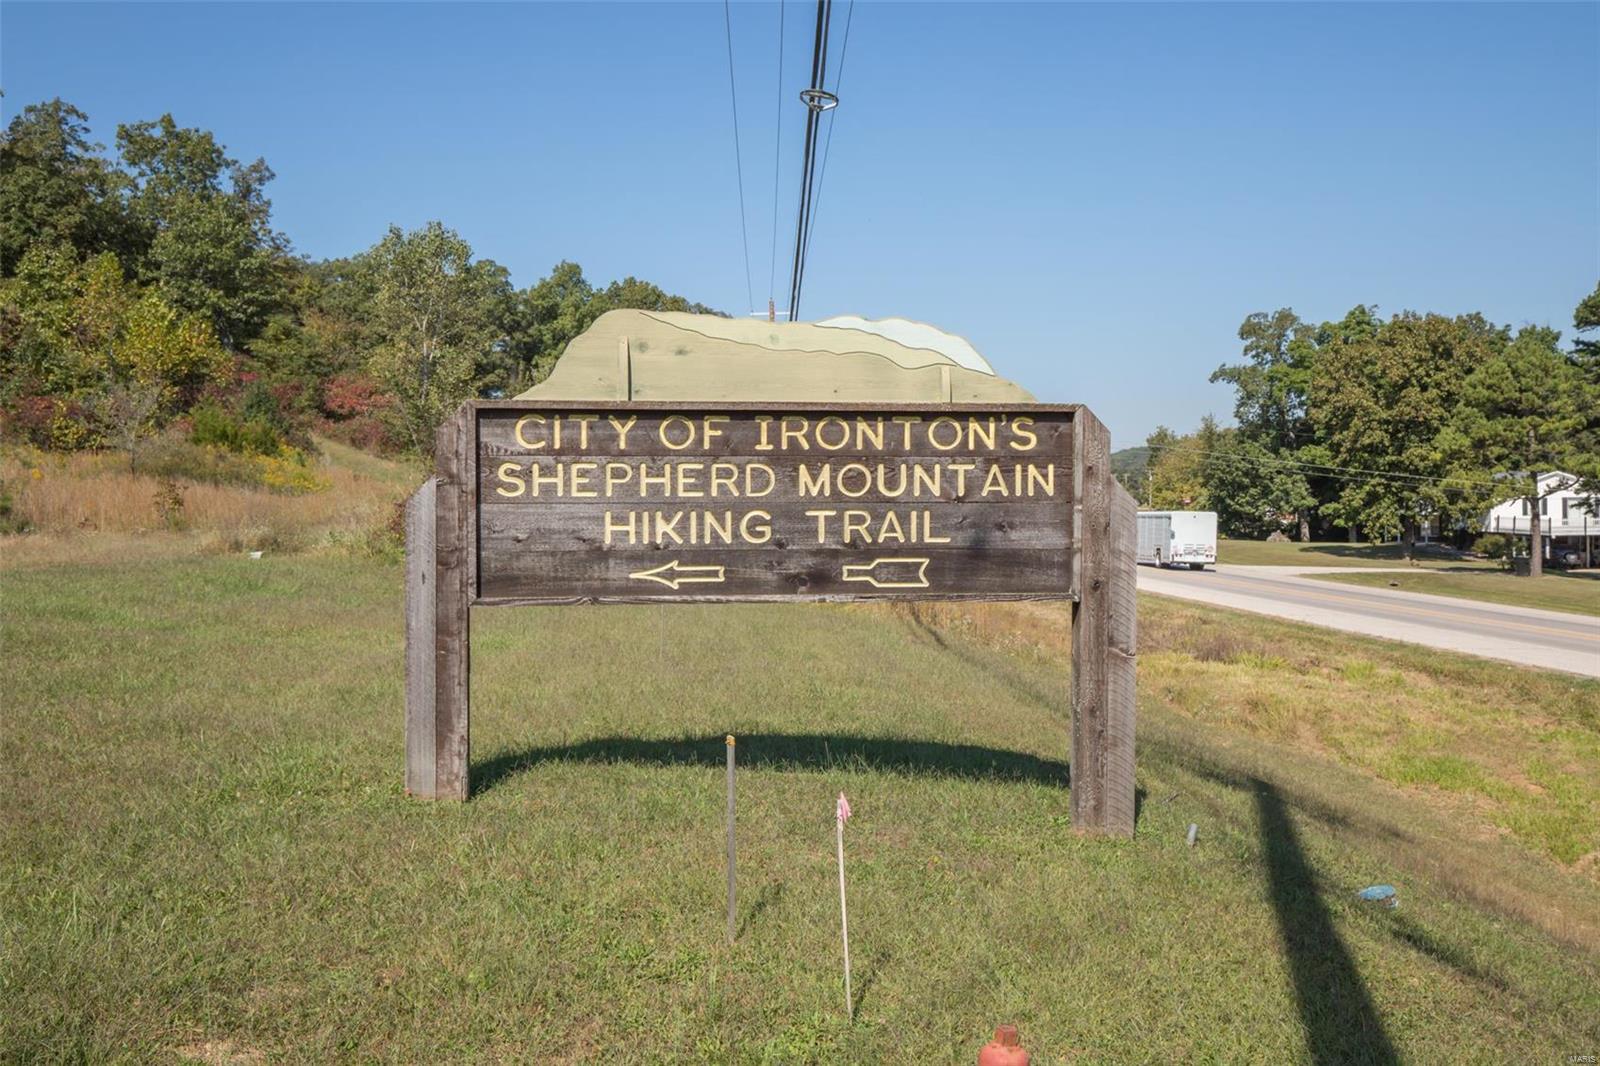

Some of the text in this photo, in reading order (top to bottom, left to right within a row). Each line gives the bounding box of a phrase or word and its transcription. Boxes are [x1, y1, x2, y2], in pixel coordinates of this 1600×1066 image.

[514, 414, 1038, 451] CITY OF IRONTON'S
[496, 462, 1055, 497] SHEPHERD MOUNTAIN
[603, 510, 951, 545] HIKING TRAIL
